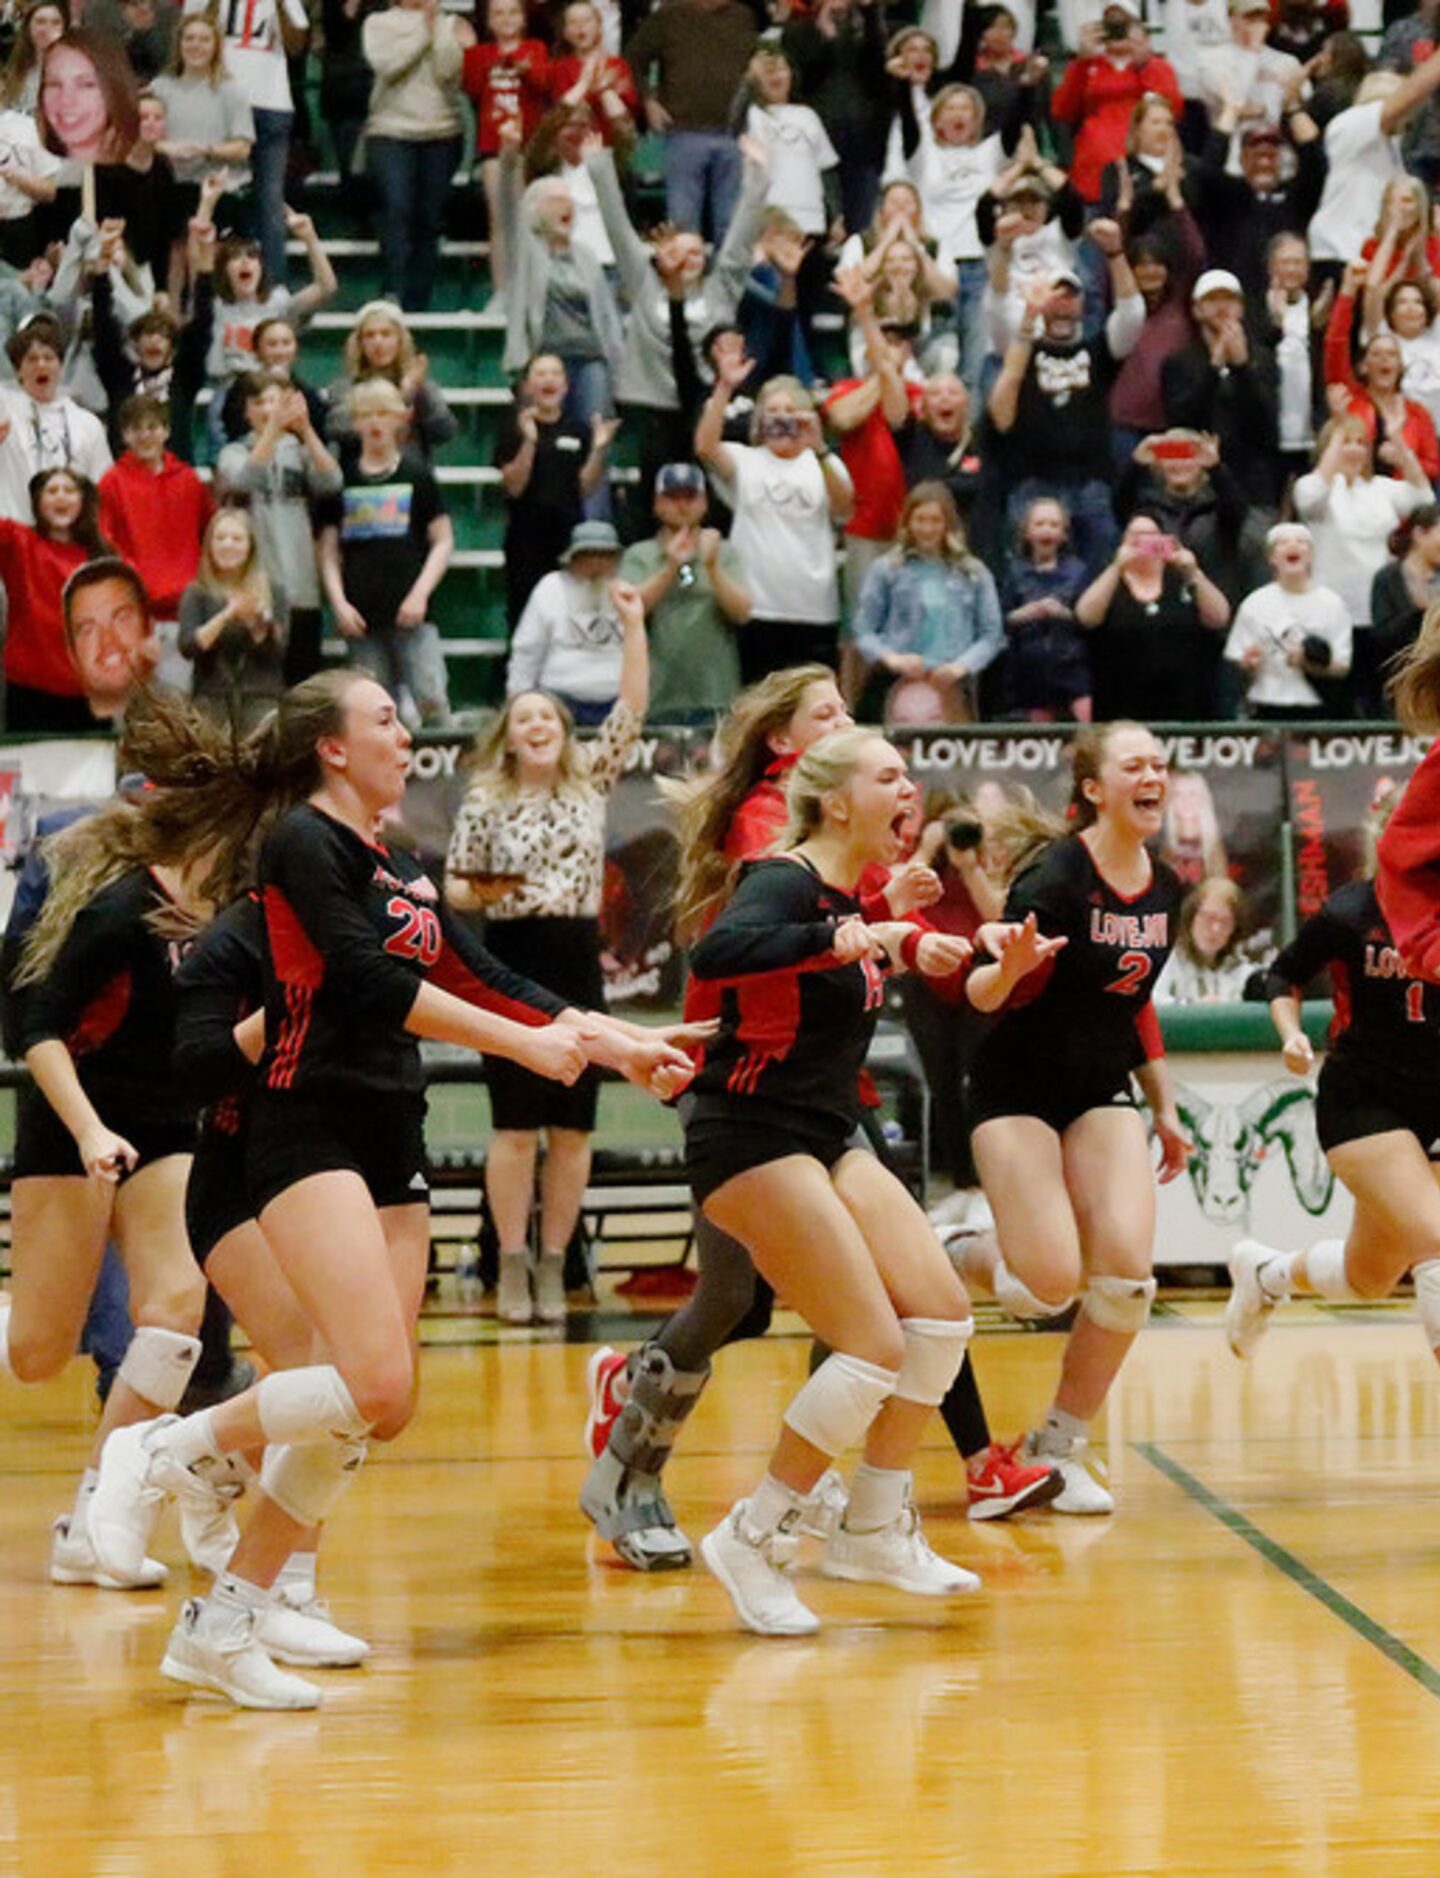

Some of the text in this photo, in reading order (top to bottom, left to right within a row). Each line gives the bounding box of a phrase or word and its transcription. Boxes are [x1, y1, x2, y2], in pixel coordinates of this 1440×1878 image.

[912, 738, 1063, 769] LOVEJOY
[1309, 735, 1438, 768] LOVEJO
[382, 896, 443, 967] 20
[1103, 950, 1153, 995] 2
[1406, 981, 1427, 1022] 1
